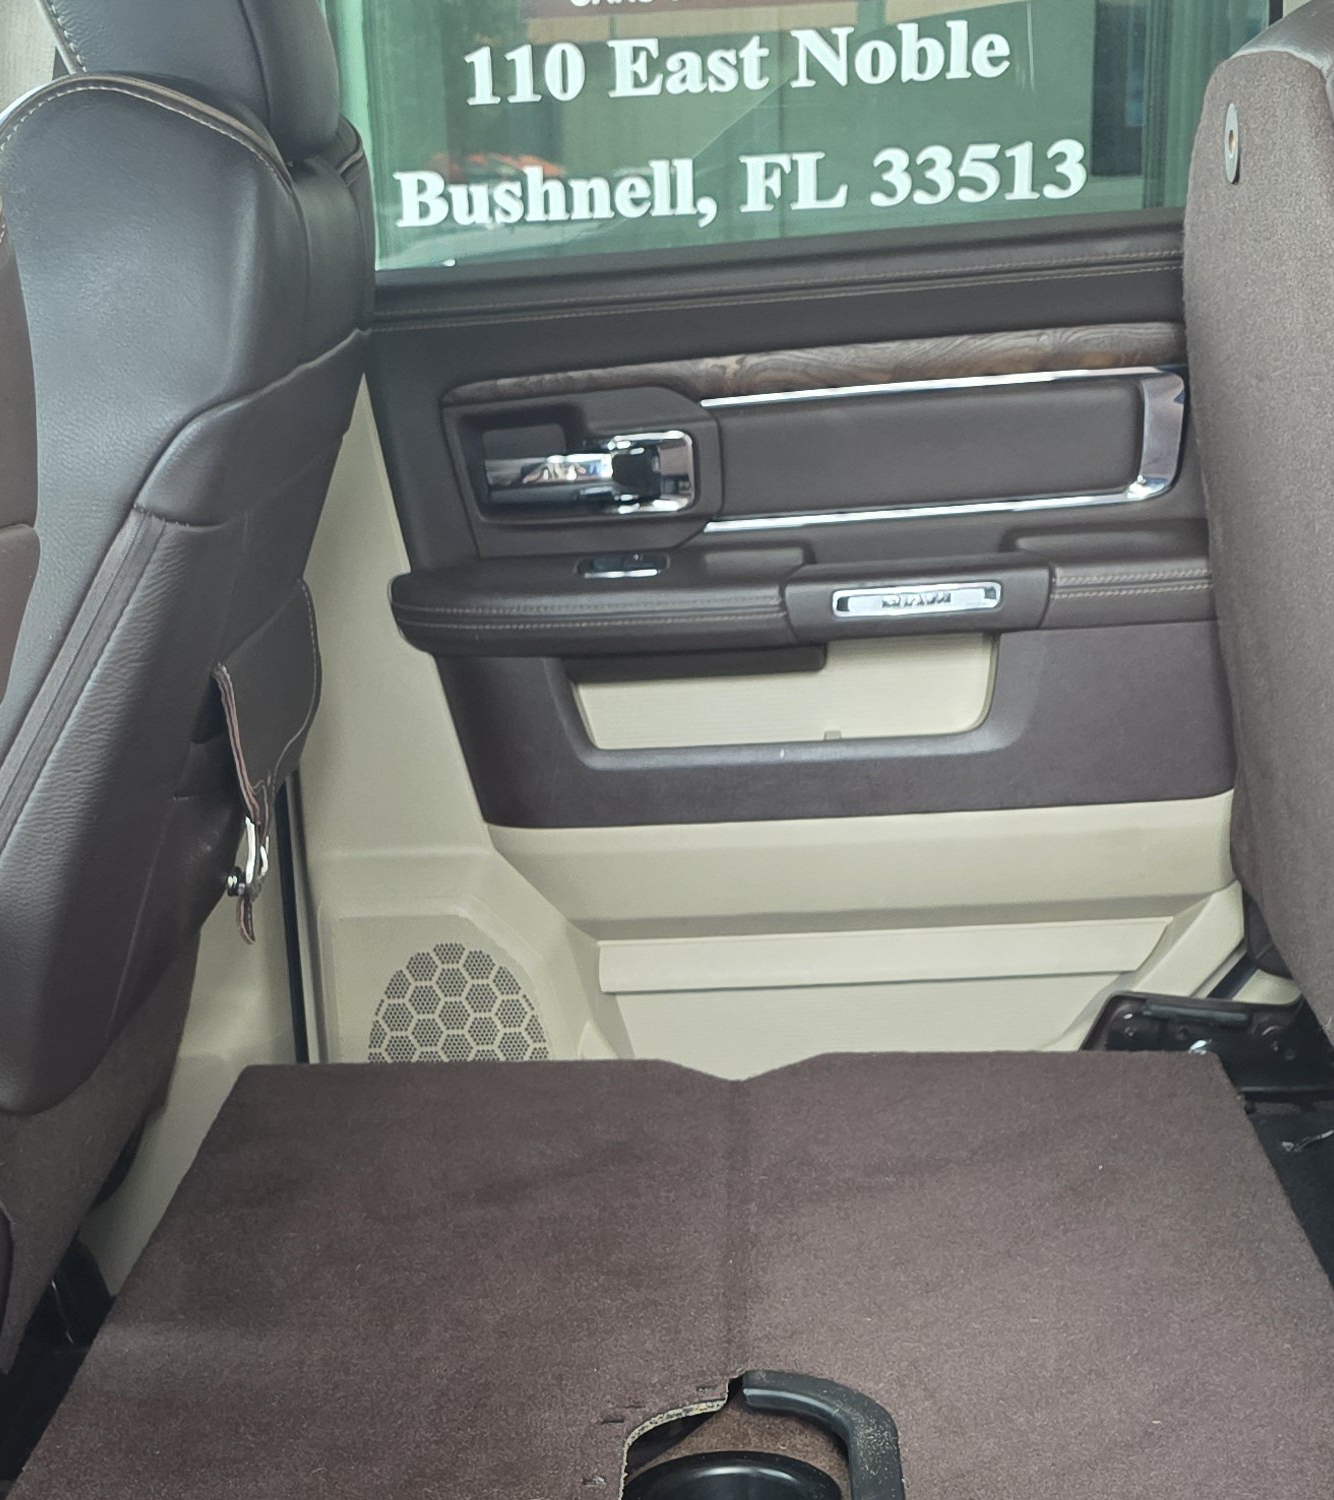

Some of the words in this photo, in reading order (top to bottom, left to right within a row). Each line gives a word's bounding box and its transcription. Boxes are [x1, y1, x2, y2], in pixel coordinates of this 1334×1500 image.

[463, 42, 586, 106] 110
[606, 35, 770, 98] East
[789, 19, 1011, 88] Noble
[392, 157, 717, 229] Bushnell,
[738, 151, 849, 212] FL
[870, 139, 1087, 208] 33513
